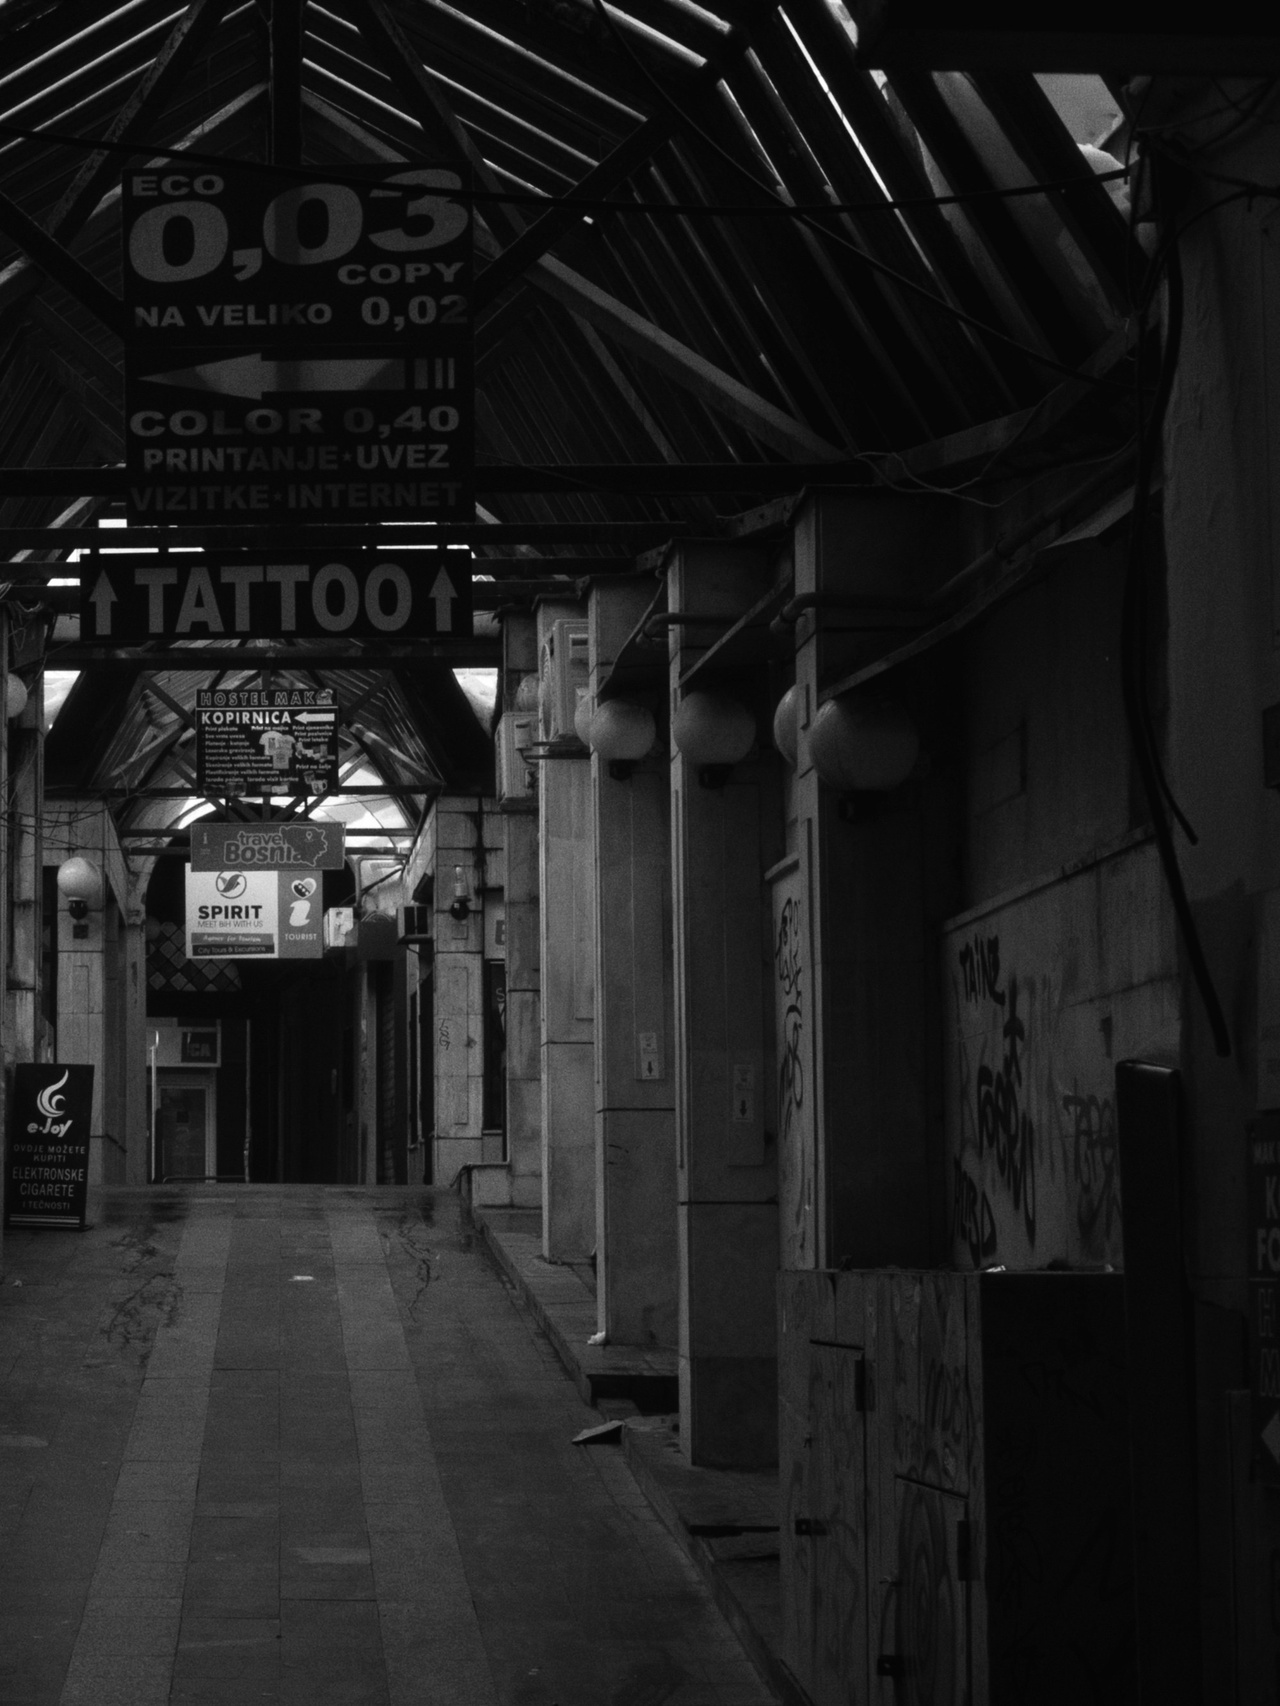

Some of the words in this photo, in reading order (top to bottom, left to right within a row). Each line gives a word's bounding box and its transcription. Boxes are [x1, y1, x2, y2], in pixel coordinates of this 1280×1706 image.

[131, 174, 225, 197] ECO
[128, 168, 470, 284] 0,03
[336, 261, 465, 286] COPY
[134, 305, 186, 328] NA
[196, 302, 333, 326] VELIKO
[360, 294, 468, 332] 0,02
[129, 407, 325, 437] COLOR
[342, 405, 460, 439] 0,40
[143, 445, 339, 473] PRINTANJE
[355, 443, 450, 470] UVEZ
[129, 484, 270, 512] VIZITKE
[287, 481, 462, 509] INTERNET
[133, 562, 413, 634] TATTOO
[200, 691, 269, 707] HOSTEL
[201, 711, 292, 725] KOPIRNICA
[198, 905, 263, 920] SPIRIT
[284, 933, 317, 941] TOURIST
[12, 1166, 85, 1182] ELEKTRONSKE
[19, 1182, 75, 1197] CIGARETE
